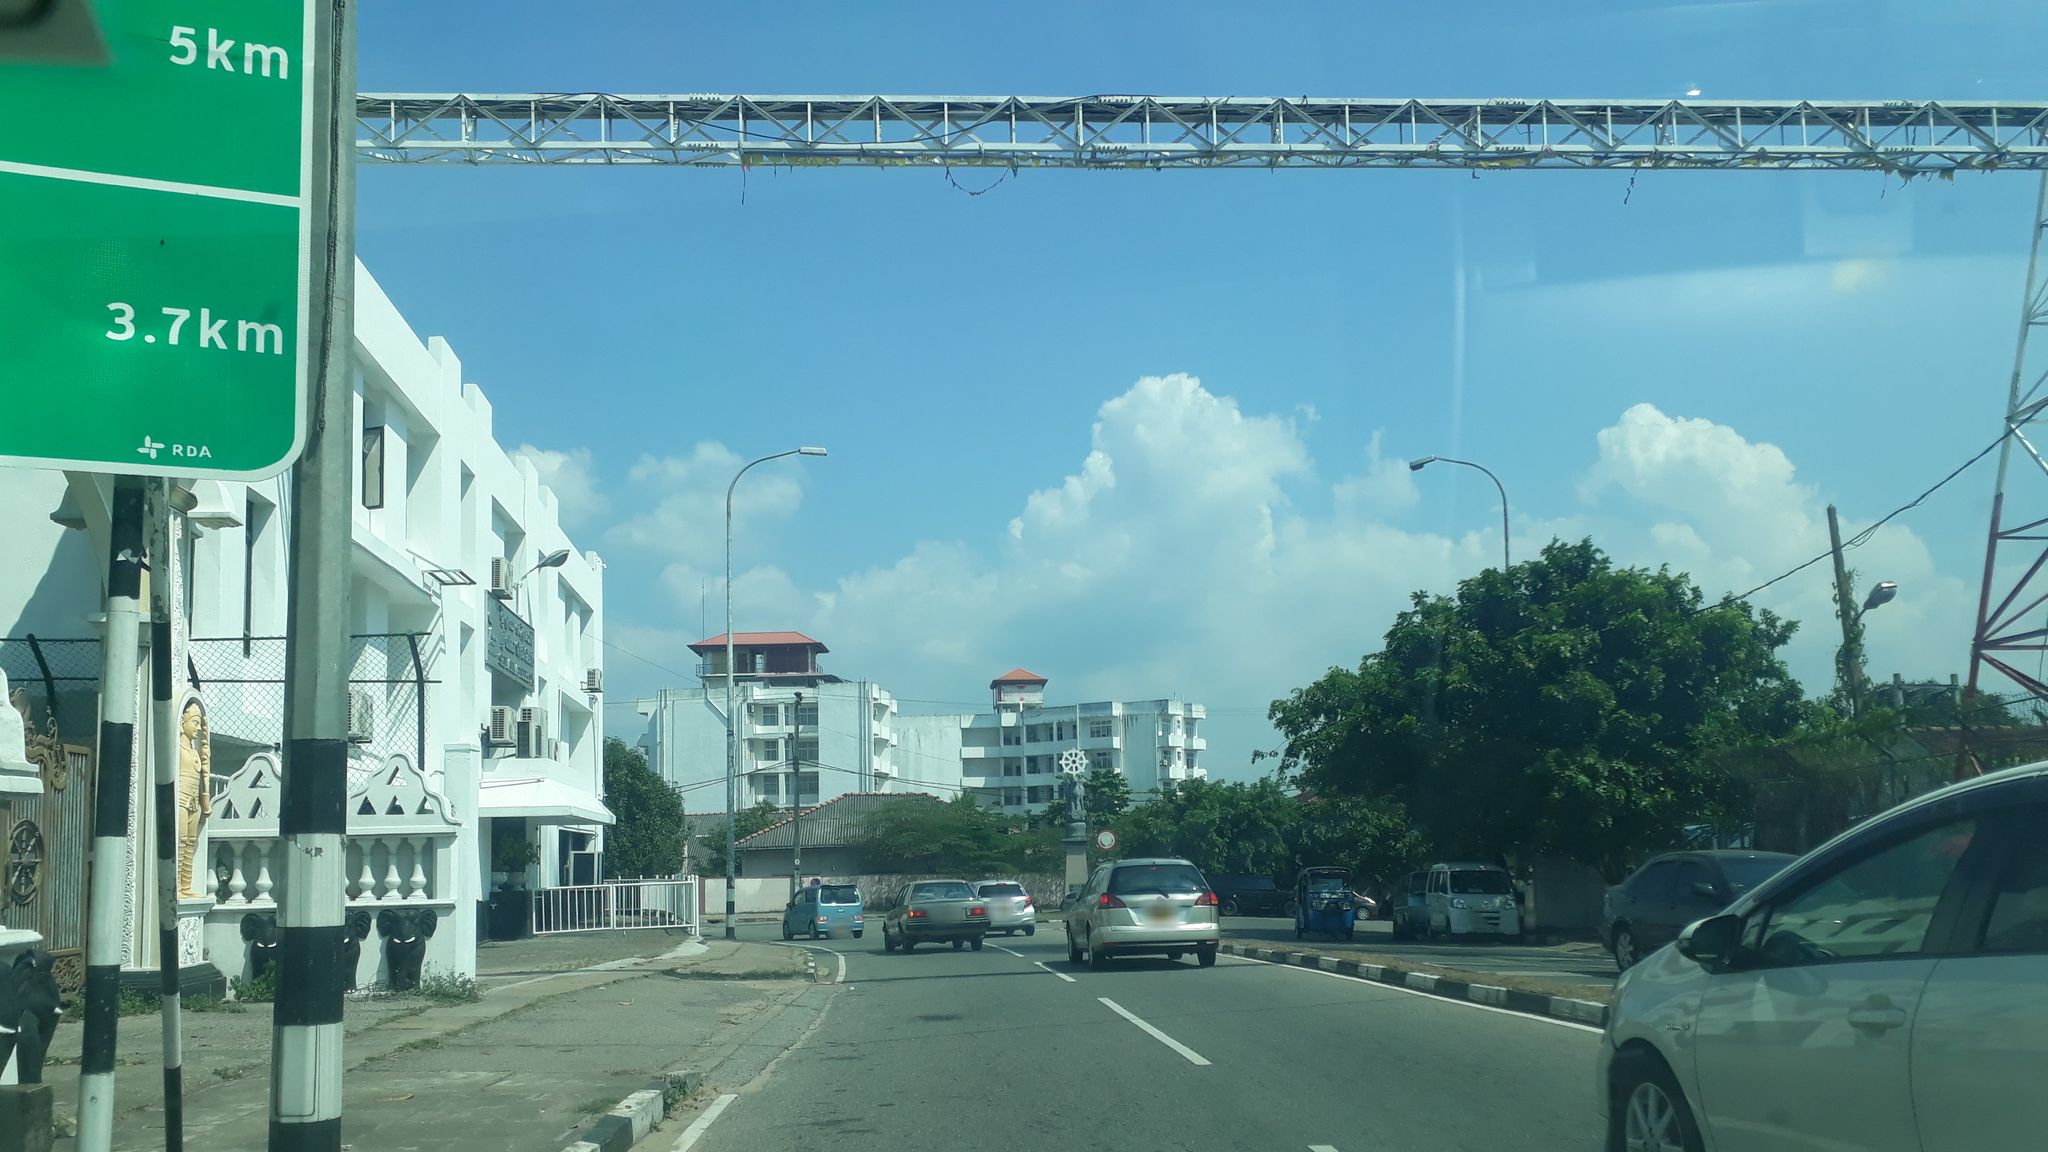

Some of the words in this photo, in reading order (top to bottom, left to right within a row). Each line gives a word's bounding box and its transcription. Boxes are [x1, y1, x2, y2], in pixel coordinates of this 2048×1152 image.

[169, 25, 289, 80] 5km
[105, 302, 283, 355] 3.7km
[172, 444, 212, 458] RDA
